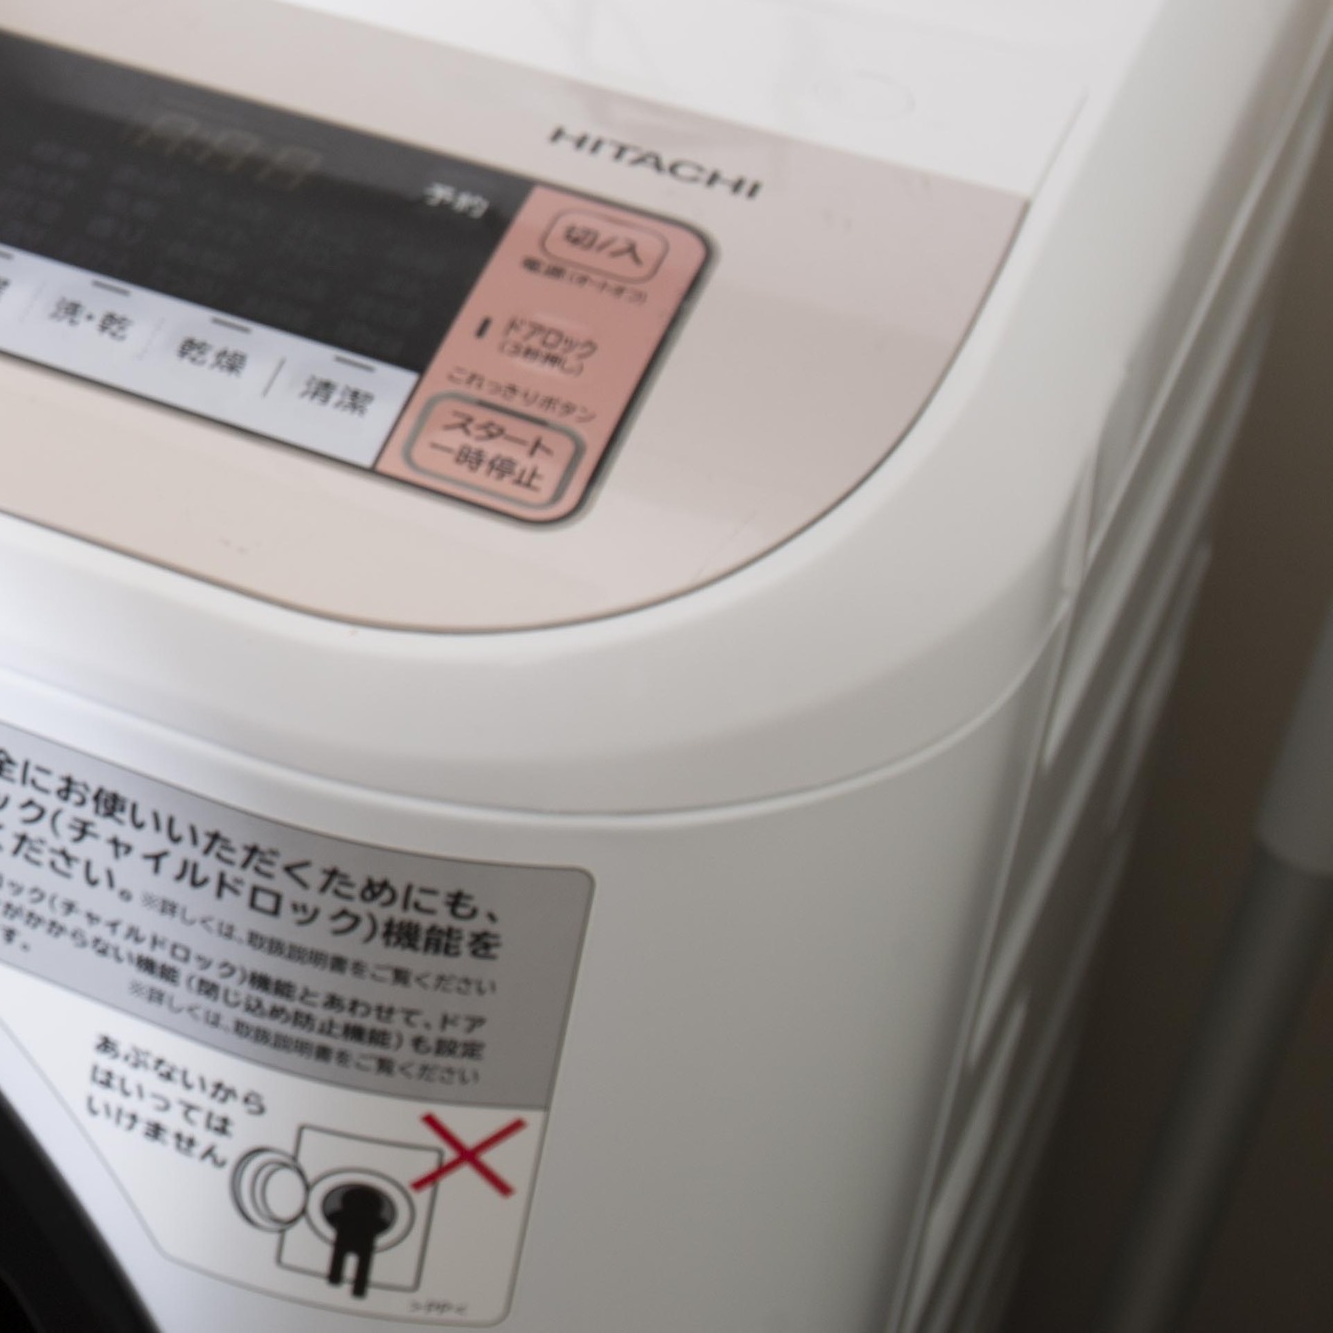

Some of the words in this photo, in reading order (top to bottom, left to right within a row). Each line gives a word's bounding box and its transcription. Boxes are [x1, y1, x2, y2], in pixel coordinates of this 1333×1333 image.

[548, 124, 764, 201] HITACHI
[423, 183, 490, 220] 予約
[175, 336, 248, 379] 乾燥
[503, 317, 598, 361] ドアロック
[298, 374, 375, 418] 清潔
[446, 366, 596, 426] これっきりボタン
[442, 410, 555, 460] スタート
[428, 441, 543, 494] 一時停止
[90, 1064, 235, 1138] はいっては
[94, 1034, 268, 1118] あぶないから
[86, 1095, 229, 1171] いけません
